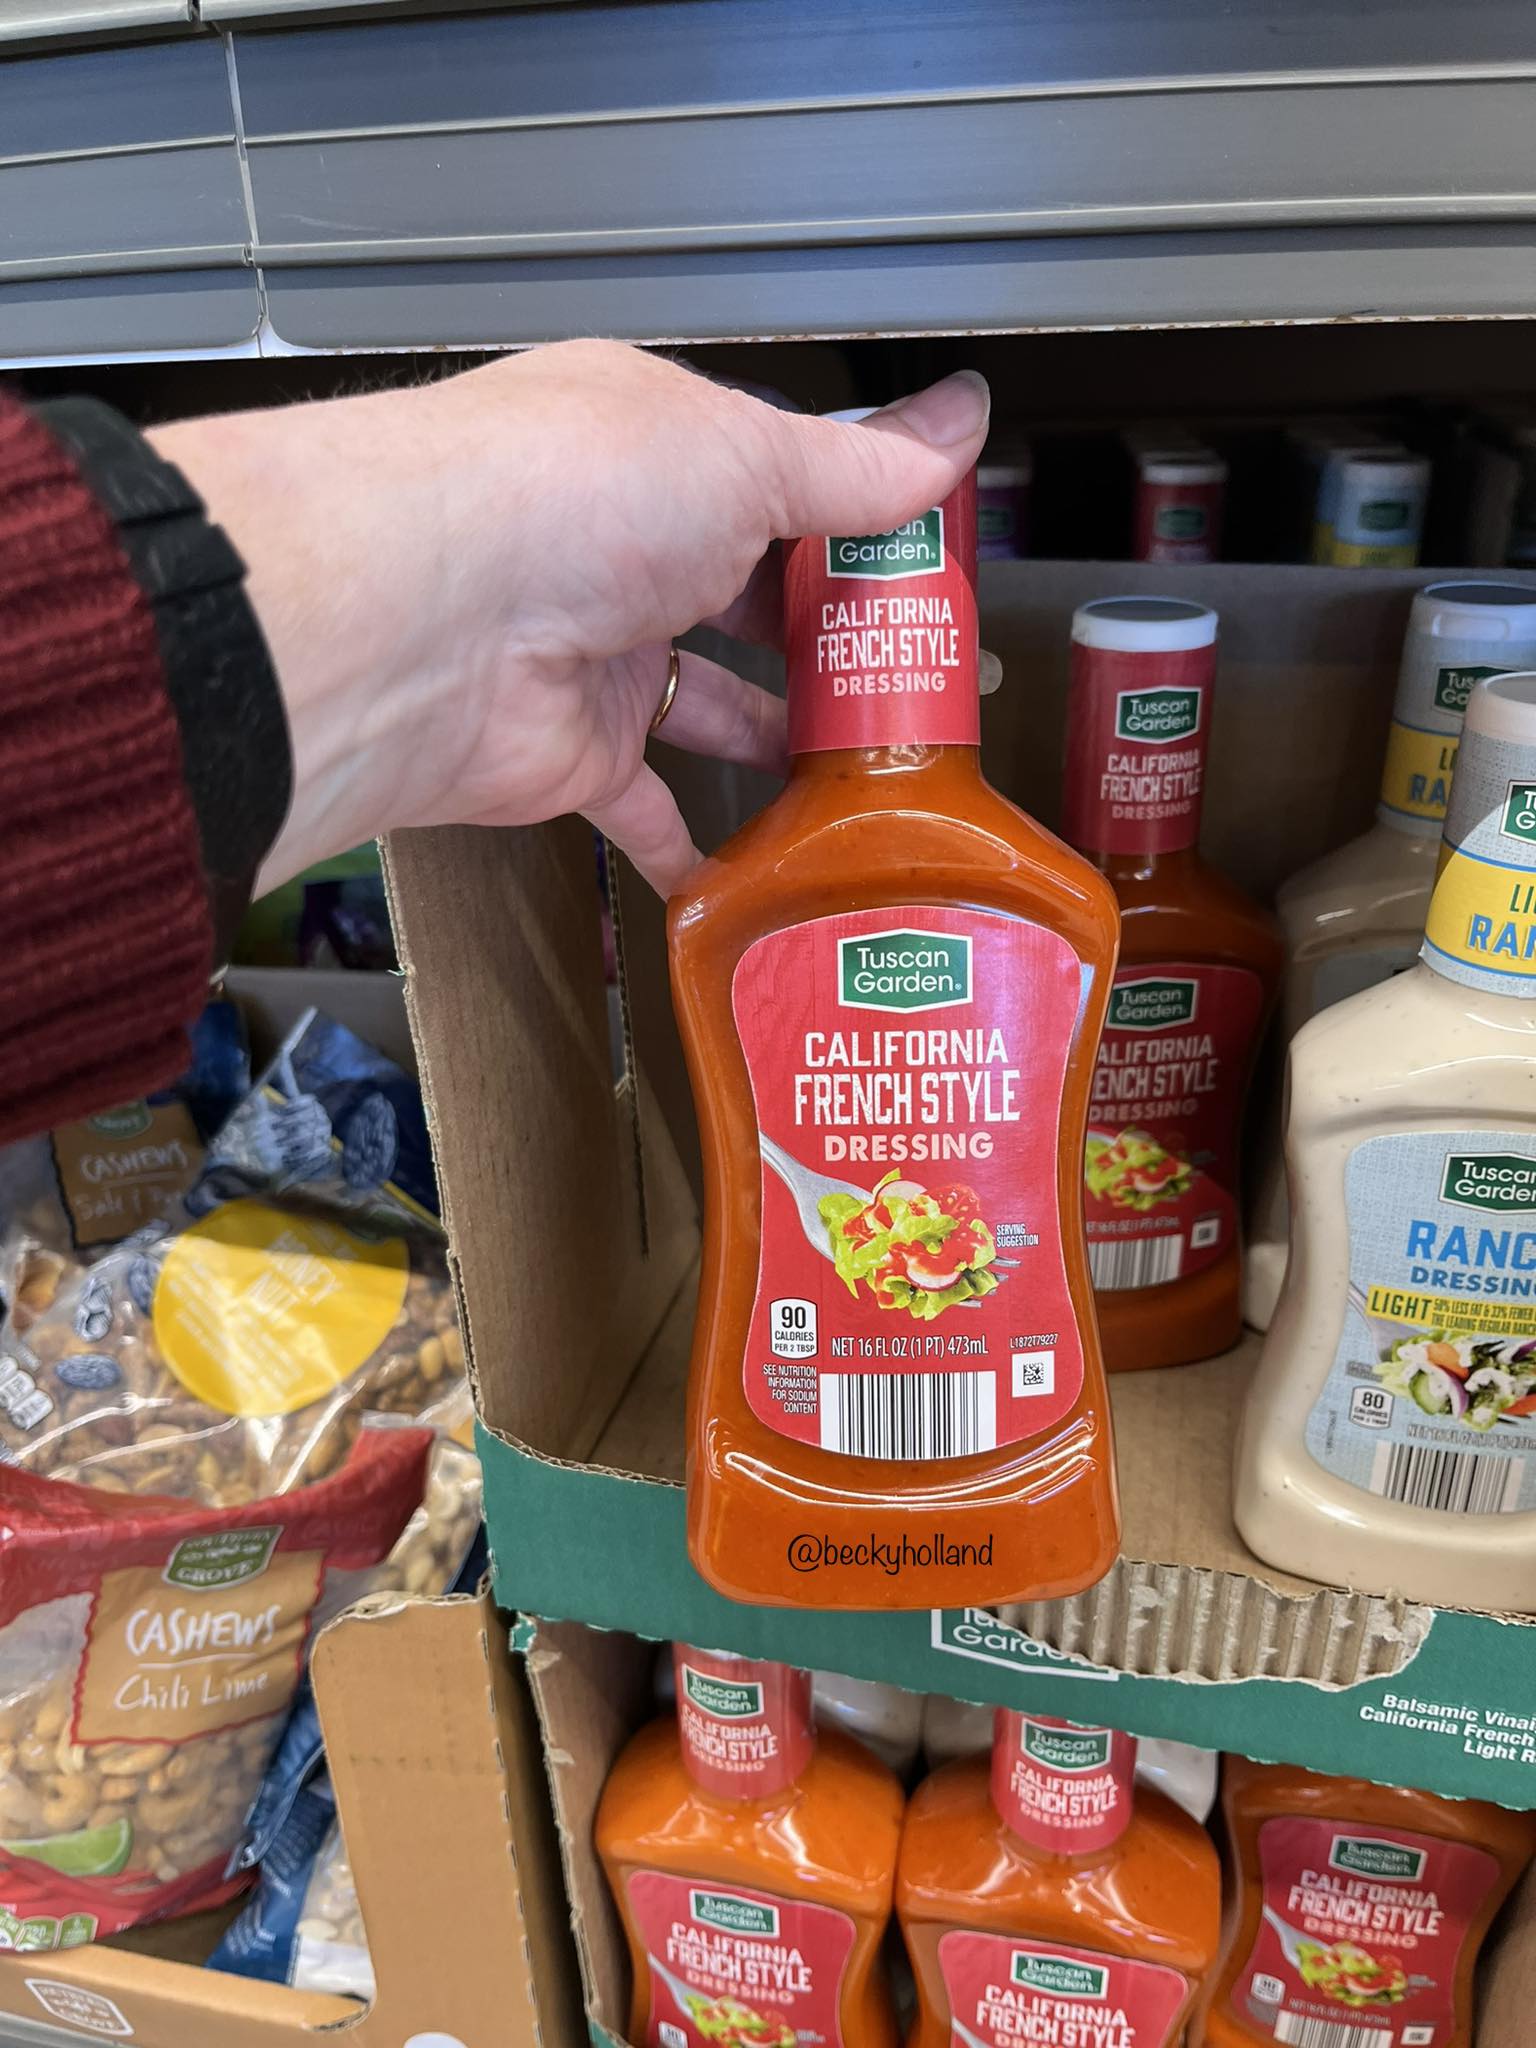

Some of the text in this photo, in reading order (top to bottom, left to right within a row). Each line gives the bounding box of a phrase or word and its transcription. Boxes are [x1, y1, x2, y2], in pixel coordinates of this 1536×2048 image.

[839, 538, 930, 564] Garden
[822, 598, 953, 630] CALIFORNIA
[817, 629, 960, 673] FRENCH STYLE
[833, 672, 946, 697] DRESSING
[1131, 698, 1190, 716] Tuscan
[1126, 715, 1191, 731] Garden
[1107, 749, 1199, 773] CALIFORNIA
[1101, 768, 1203, 802] FRENCH STYLE
[1112, 803, 1192, 820] DRESSING
[857, 947, 949, 970] Tuscan
[853, 970, 954, 994] Garden
[1120, 989, 1183, 1005] Tuscan
[1117, 1004, 1183, 1020] Garden
[805, 1029, 1009, 1067] CALIFORNIA
[1097, 1035, 1213, 1065] ALIFORNIA
[1152, 1058, 1218, 1098] STYLE
[794, 1069, 1021, 1126] FRENCH STYLE
[824, 1132, 994, 1162] DRESSING
[996, 1224, 1026, 1236] SERVING
[996, 1235, 1039, 1247] SUGGESTION
[1411, 1266, 1536, 1297] DRESSIN
[781, 1306, 806, 1329] 90
[1371, 1290, 1432, 1321] LIGHT
[1452, 1301, 1469, 1315] LESS
[775, 1330, 814, 1342] CALORIES
[775, 1343, 788, 1352] PER
[797, 1344, 815, 1353] TBSP
[832, 1335, 989, 1359] NET 16 FL OZ (1 PT) 473mL
[763, 1364, 817, 1377] SEE NUTRITION
[768, 1377, 817, 1389] INFORMATION
[772, 1389, 817, 1402] FOR SODIUM
[783, 1402, 817, 1414] CONTENT
[1362, 1391, 1384, 1409] 80
[127, 1606, 281, 1656] CASHEWS
[114, 1672, 269, 1711] Chili Lime
[691, 1675, 748, 1700] Tuscan
[1382, 1693, 1536, 1733] Balsamic Vinai
[1033, 1728, 1098, 1750] Tuscan
[1360, 1705, 1535, 1748] California French
[728, 1735, 778, 1761] STYLE
[1463, 1739, 1517, 1761] Light
[1015, 1760, 1115, 1794] CALIFORNIA
[1011, 1771, 1119, 1816] FRENCH STYLE
[1300, 1869, 1439, 1911] CALIFORNIA
[1288, 1885, 1445, 1936] FRENCH STYLE
[671, 1921, 804, 1966] CALIFORNIA
[1304, 1917, 1418, 1949] DRESSING
[666, 1937, 813, 1993] FRENCH STYLE
[686, 1970, 795, 2005] DRESSING
[985, 1983, 1128, 2027] CALIFORNIA
[975, 2000, 1060, 2045] FRENCH
[1061, 2020, 1136, 2048] STYLE
